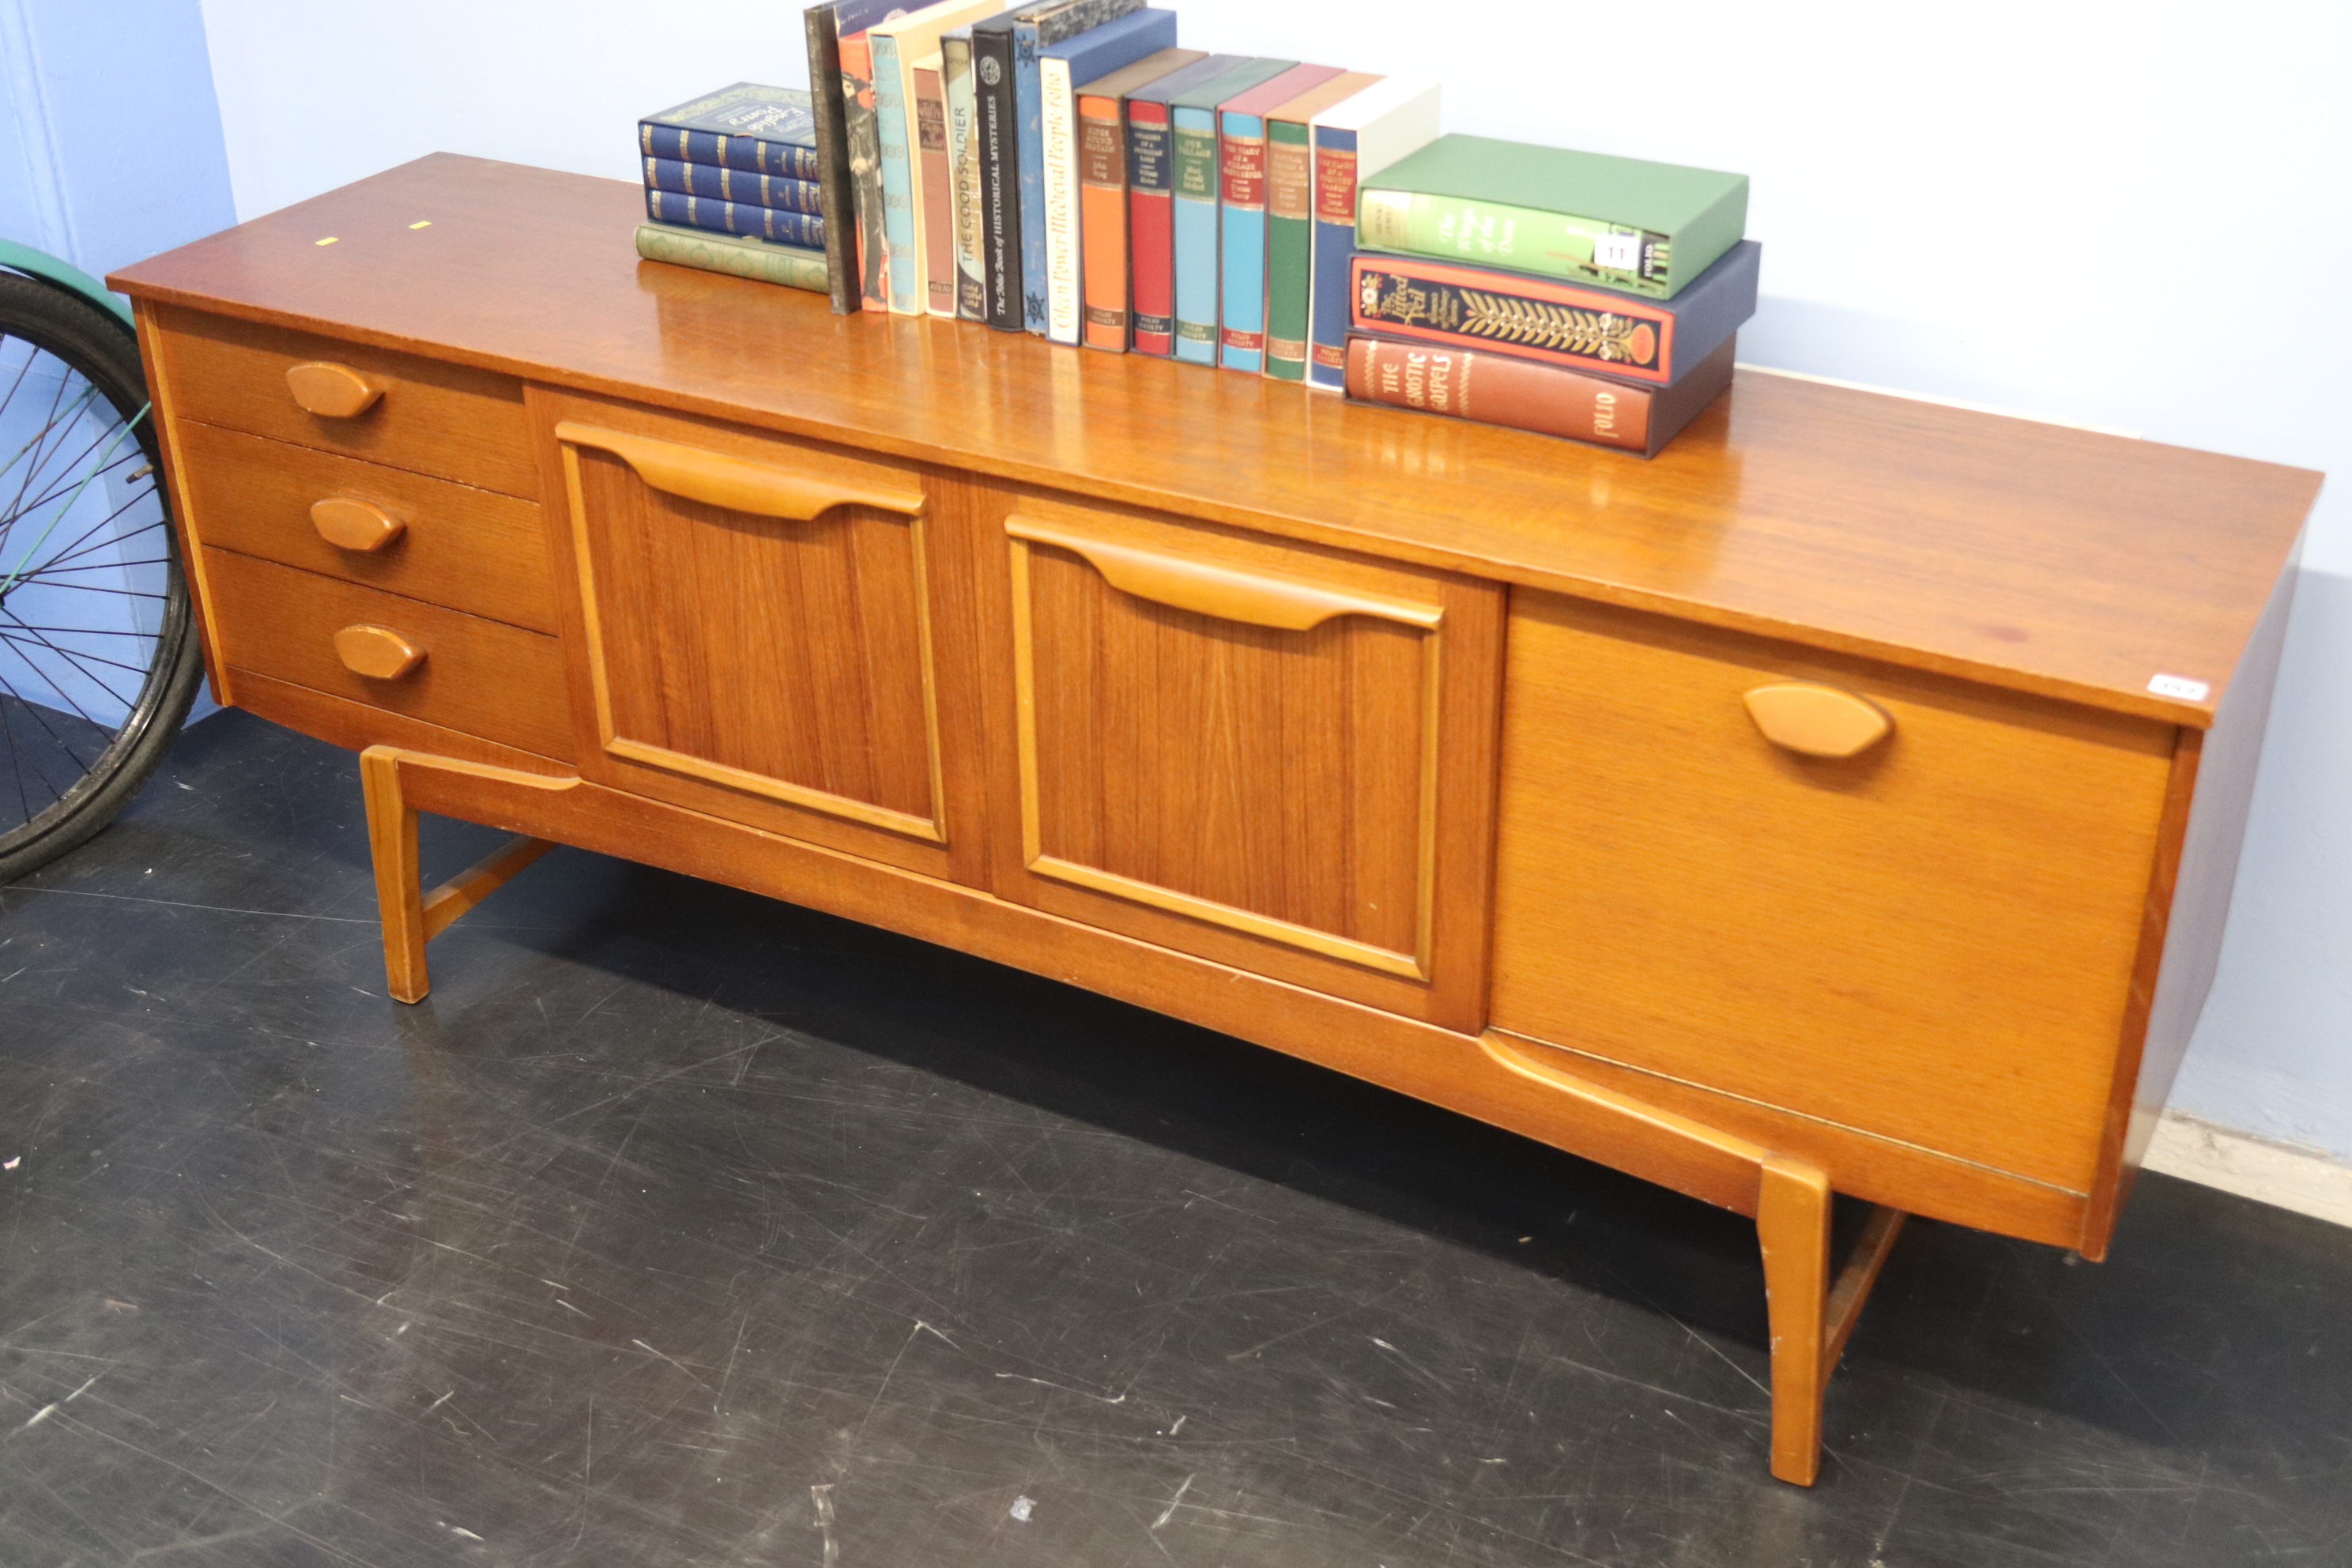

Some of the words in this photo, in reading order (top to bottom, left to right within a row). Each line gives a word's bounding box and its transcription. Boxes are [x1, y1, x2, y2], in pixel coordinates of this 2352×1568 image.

[729, 105, 783, 126] Poetry
[747, 107, 806, 133] English
[987, 96, 999, 161] MYSTERIES
[953, 107, 968, 175] SOLDIER
[958, 180, 972, 229] GOOD
[990, 164, 1002, 234] HISTORICAL
[993, 236, 1004, 248] of
[1438, 213, 1456, 243] The
[1457, 207, 1476, 254] Wings
[1498, 217, 1516, 257] Dove
[960, 233, 973, 263] THE
[994, 248, 1004, 272] Book
[1608, 246, 1624, 261] 11
[1644, 243, 1653, 277] FOLIO
[996, 273, 1005, 296] Folio
[997, 296, 1006, 315] The
[1381, 363, 1400, 394] THE
[1404, 352, 1427, 407] GNOSTIC
[1429, 355, 1452, 412] GOSPELS
[1593, 393, 1619, 438] FOLIO
